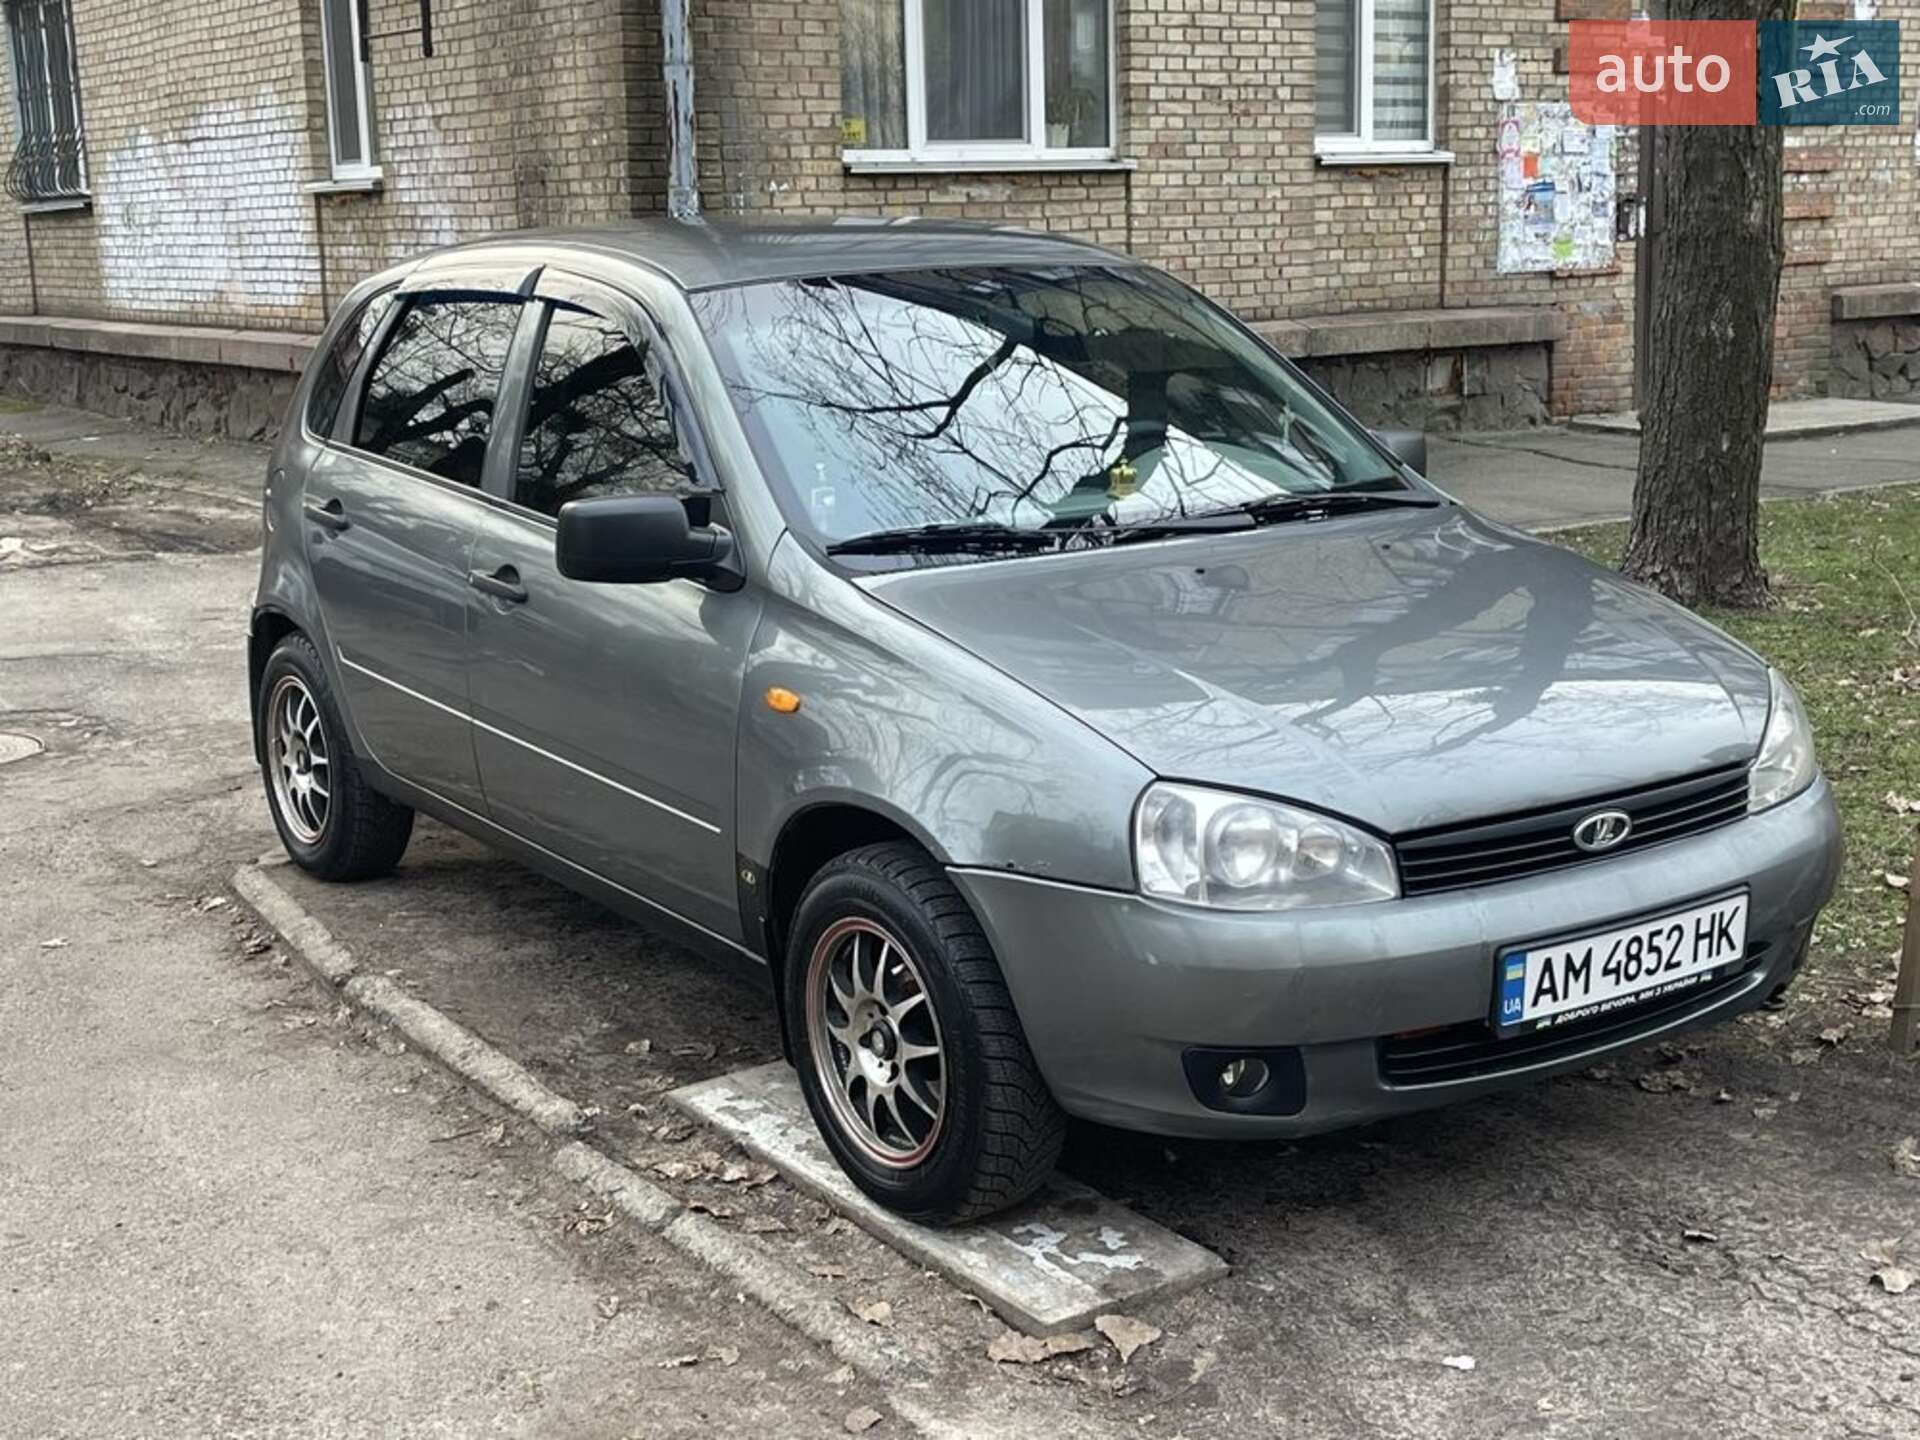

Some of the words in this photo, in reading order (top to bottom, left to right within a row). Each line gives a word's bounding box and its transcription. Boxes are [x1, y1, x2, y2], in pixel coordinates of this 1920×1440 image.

[1531, 946, 1593, 1008] AM
[1601, 923, 1685, 986] 4852
[1692, 905, 1741, 963] HK
[1503, 1000, 1522, 1015] UA
